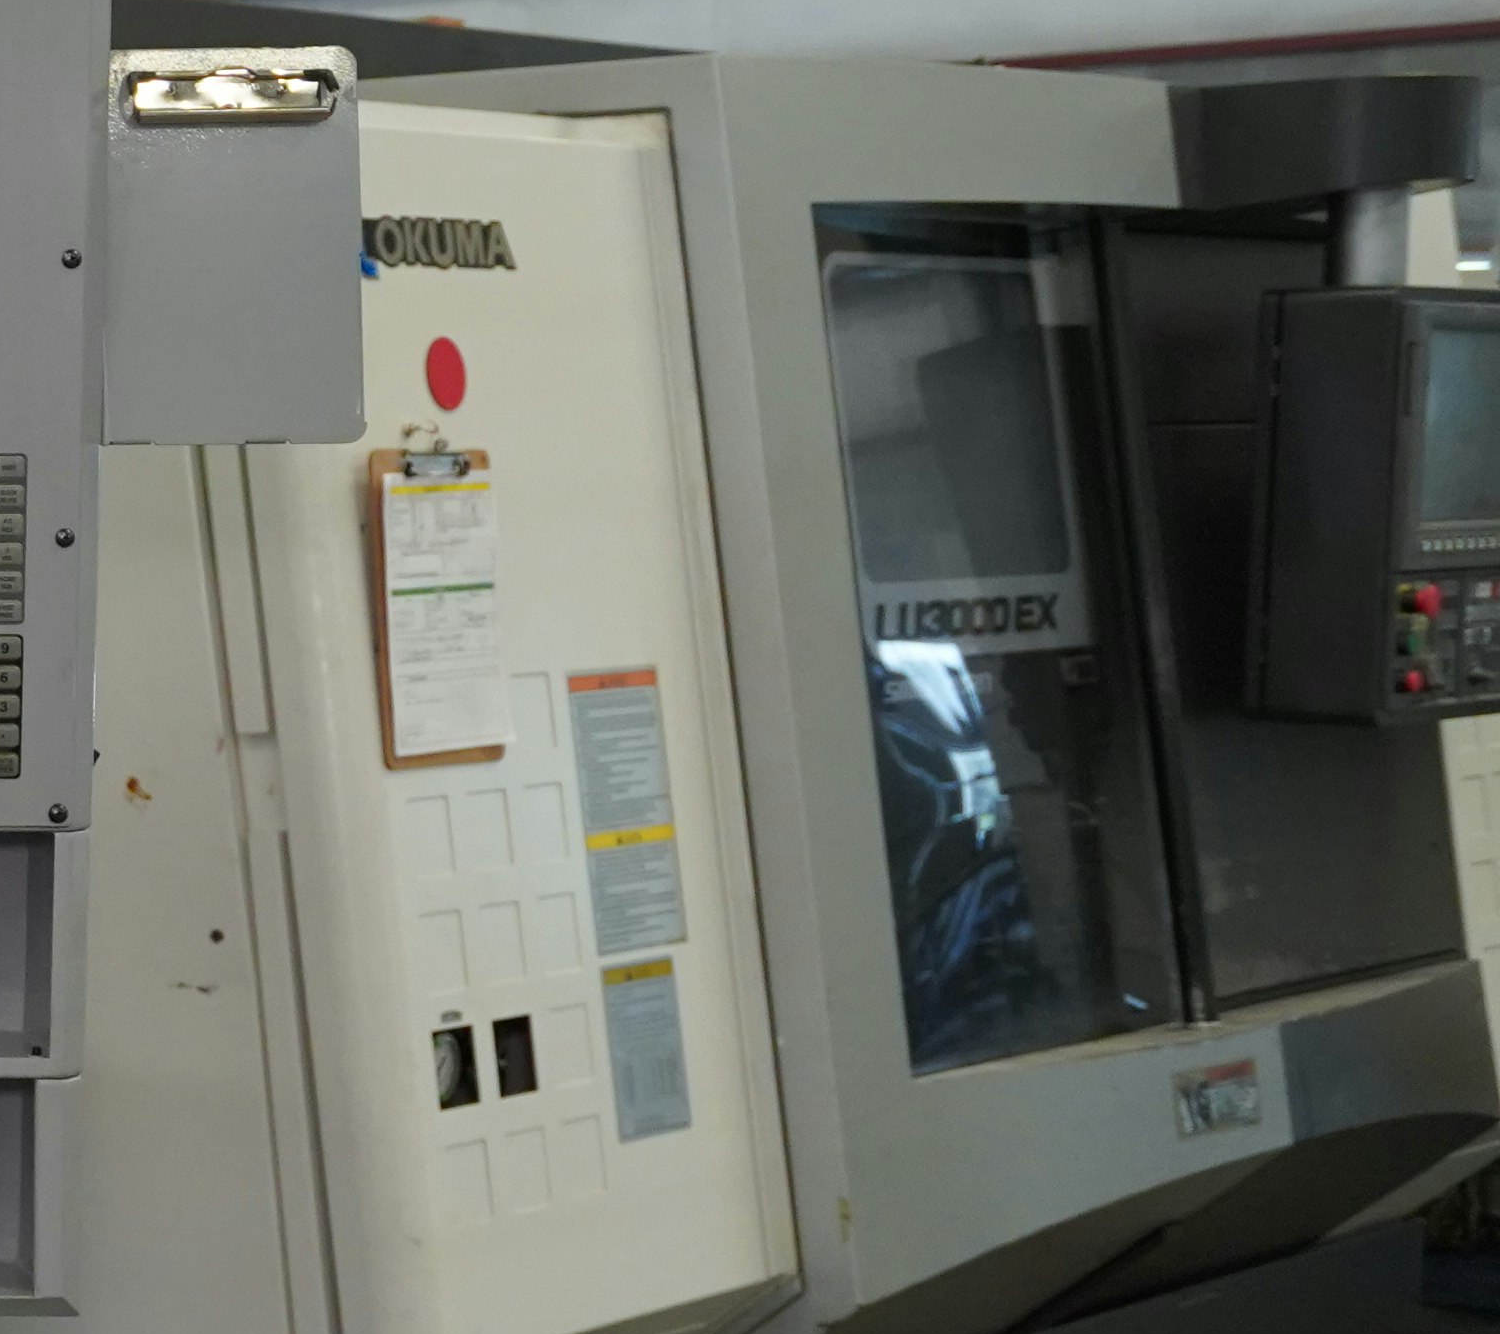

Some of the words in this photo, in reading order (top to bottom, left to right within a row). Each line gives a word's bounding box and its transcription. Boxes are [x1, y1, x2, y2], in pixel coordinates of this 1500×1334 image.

[375, 216, 517, 269] OKUMA
[1015, 593, 1059, 631] EX
[1, 643, 9, 654] 9
[0, 673, 8, 683] 6
[0, 702, 8, 712] 3
